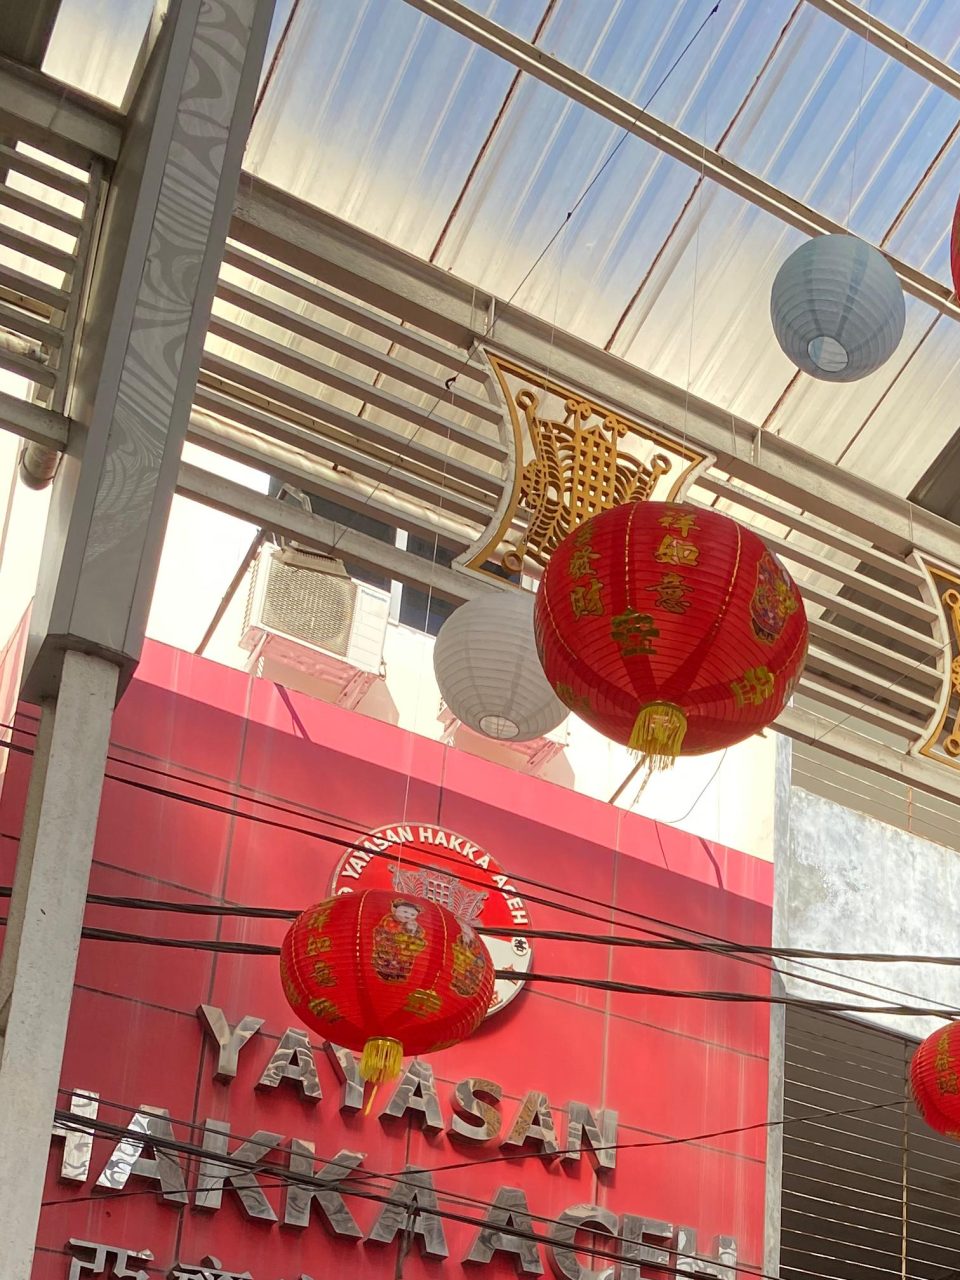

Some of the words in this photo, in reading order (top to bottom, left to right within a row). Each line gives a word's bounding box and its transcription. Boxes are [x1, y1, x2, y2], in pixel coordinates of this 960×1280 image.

[341, 826, 414, 879] YAYASAN
[418, 827, 491, 871] HAKKA
[492, 873, 529, 925] ACEH
[197, 1004, 619, 1171] YAYASAN
[51, 1088, 450, 1262] HAKKA
